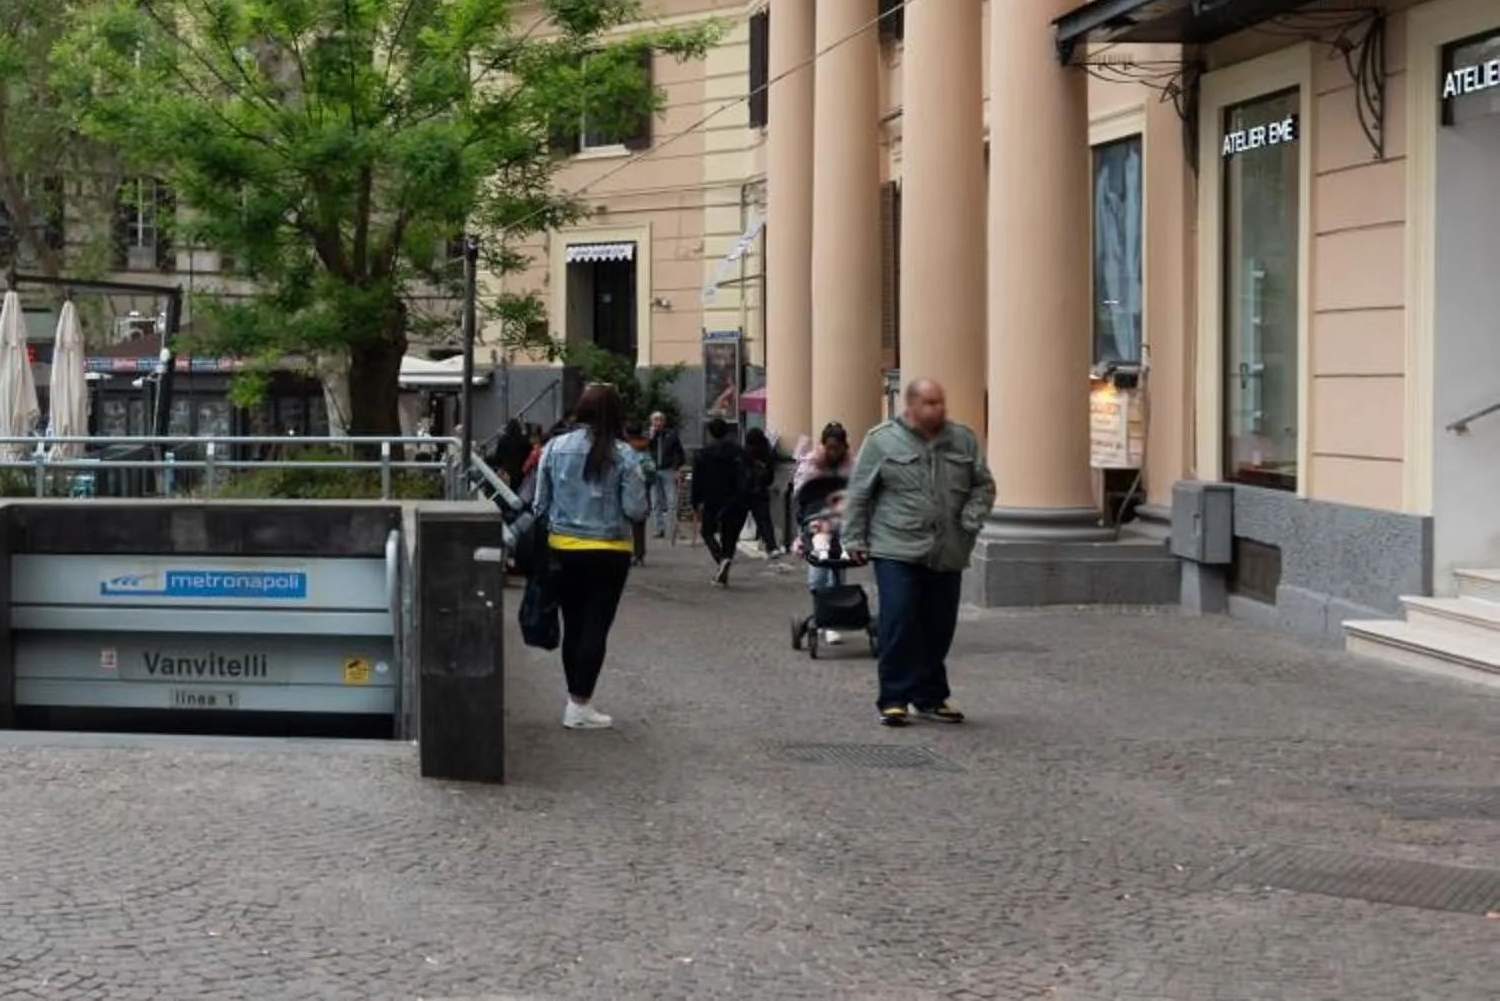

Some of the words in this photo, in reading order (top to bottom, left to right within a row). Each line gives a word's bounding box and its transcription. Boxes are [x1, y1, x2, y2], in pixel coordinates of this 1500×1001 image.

[1443, 58, 1500, 98] ATELIE
[1222, 125, 1266, 156] ATELIER
[170, 573, 299, 591] metronapoli
[143, 651, 268, 677] Vanvitelli
[174, 690, 217, 706] linea
